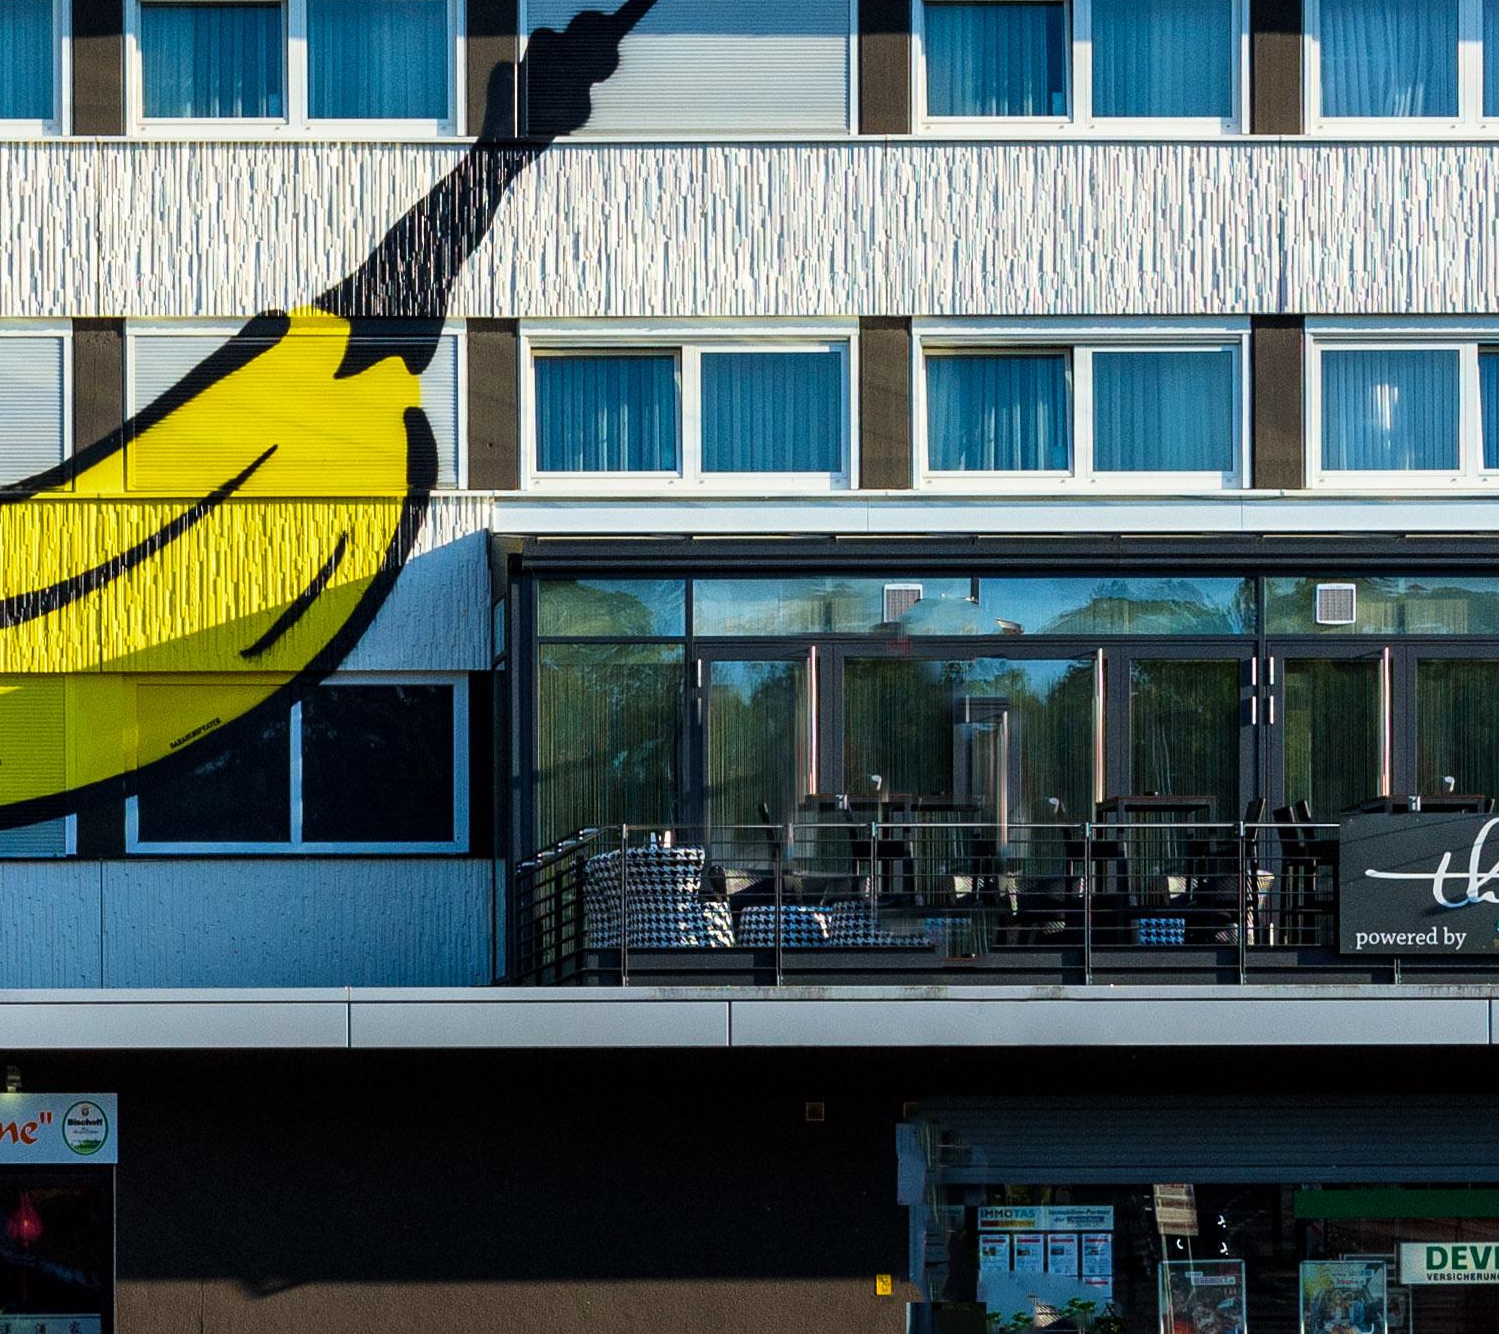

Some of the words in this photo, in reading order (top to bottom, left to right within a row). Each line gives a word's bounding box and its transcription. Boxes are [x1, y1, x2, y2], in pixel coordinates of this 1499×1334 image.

[1355, 929, 1437, 949] powered
[1444, 928, 1467, 949] by
[980, 1208, 1036, 1219] IMMOTAS
